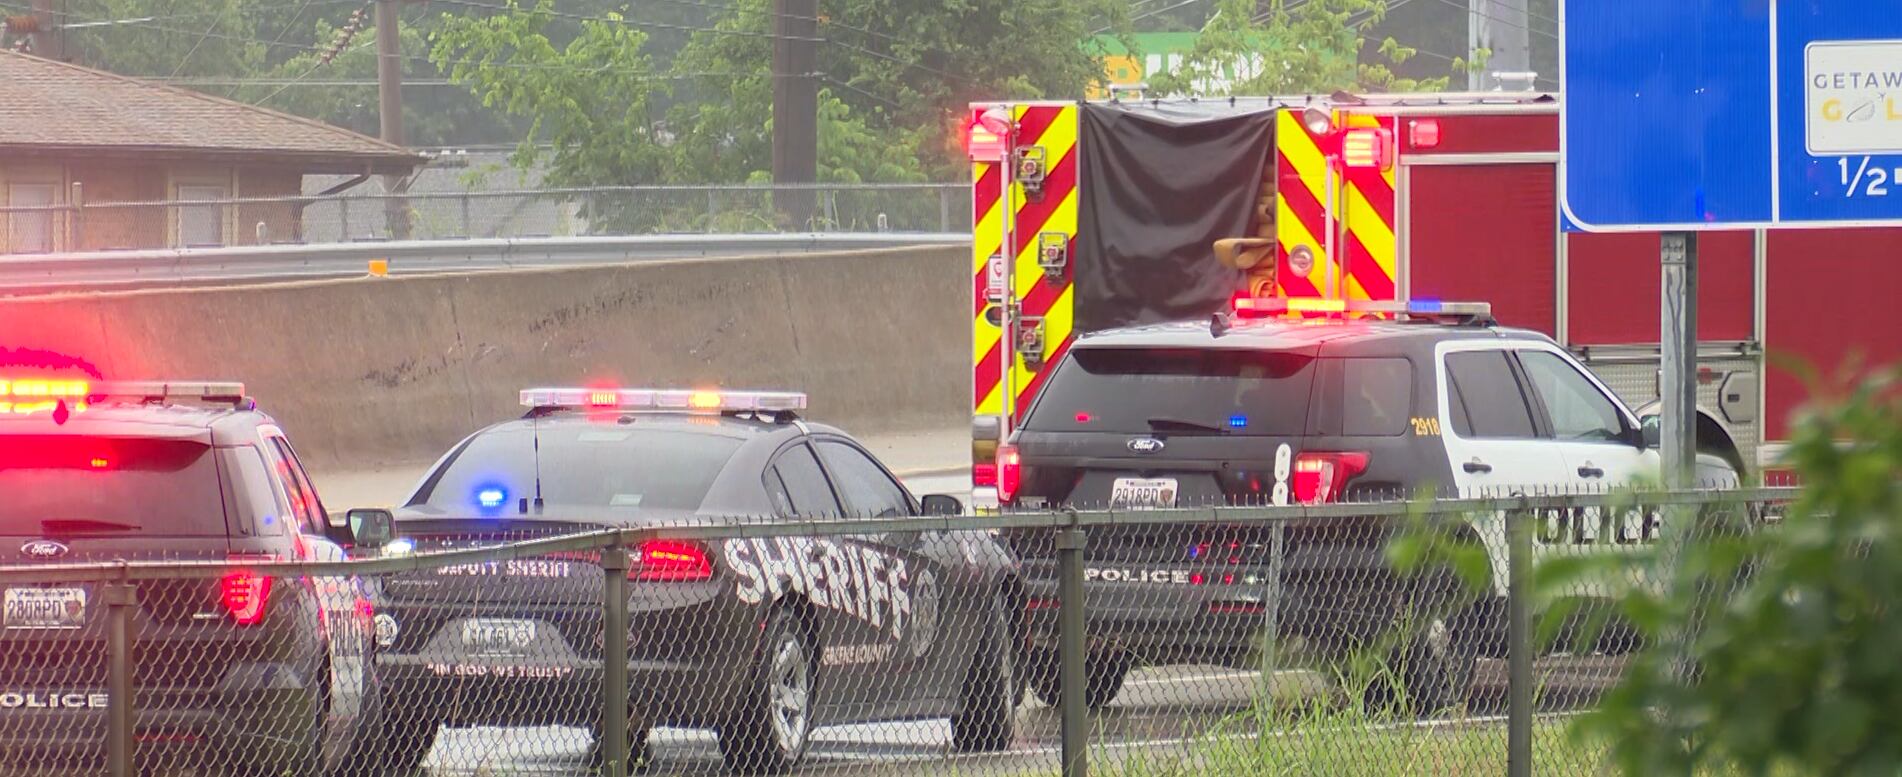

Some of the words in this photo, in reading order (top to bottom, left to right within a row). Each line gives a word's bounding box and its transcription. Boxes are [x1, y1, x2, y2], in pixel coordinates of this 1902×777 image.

[1838, 156, 1888, 197] 1/2
[1411, 417, 1440, 436] 2918
[1115, 488, 1159, 505] 2918PD
[1530, 506, 1661, 545] OLICE
[507, 559, 569, 577] SHERIFF
[1084, 568, 1190, 584] POLICE
[724, 536, 910, 640] SHERIFF
[455, 664, 488, 676] GOD
